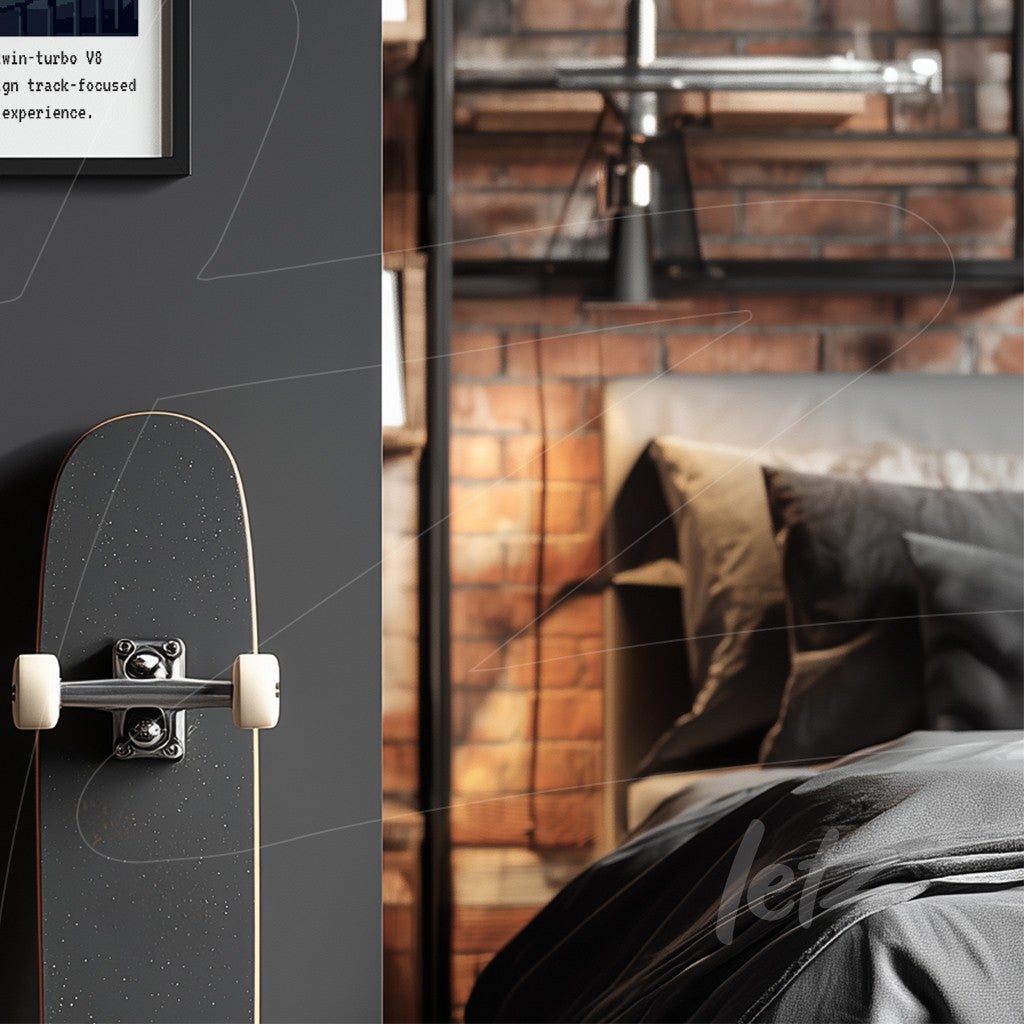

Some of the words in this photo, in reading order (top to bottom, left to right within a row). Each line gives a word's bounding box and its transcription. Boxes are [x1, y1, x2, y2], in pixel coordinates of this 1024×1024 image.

[86, 51, 101, 64] V8
[28, 79, 136, 91] track-focused
[2, 106, 91, 122] experience.
